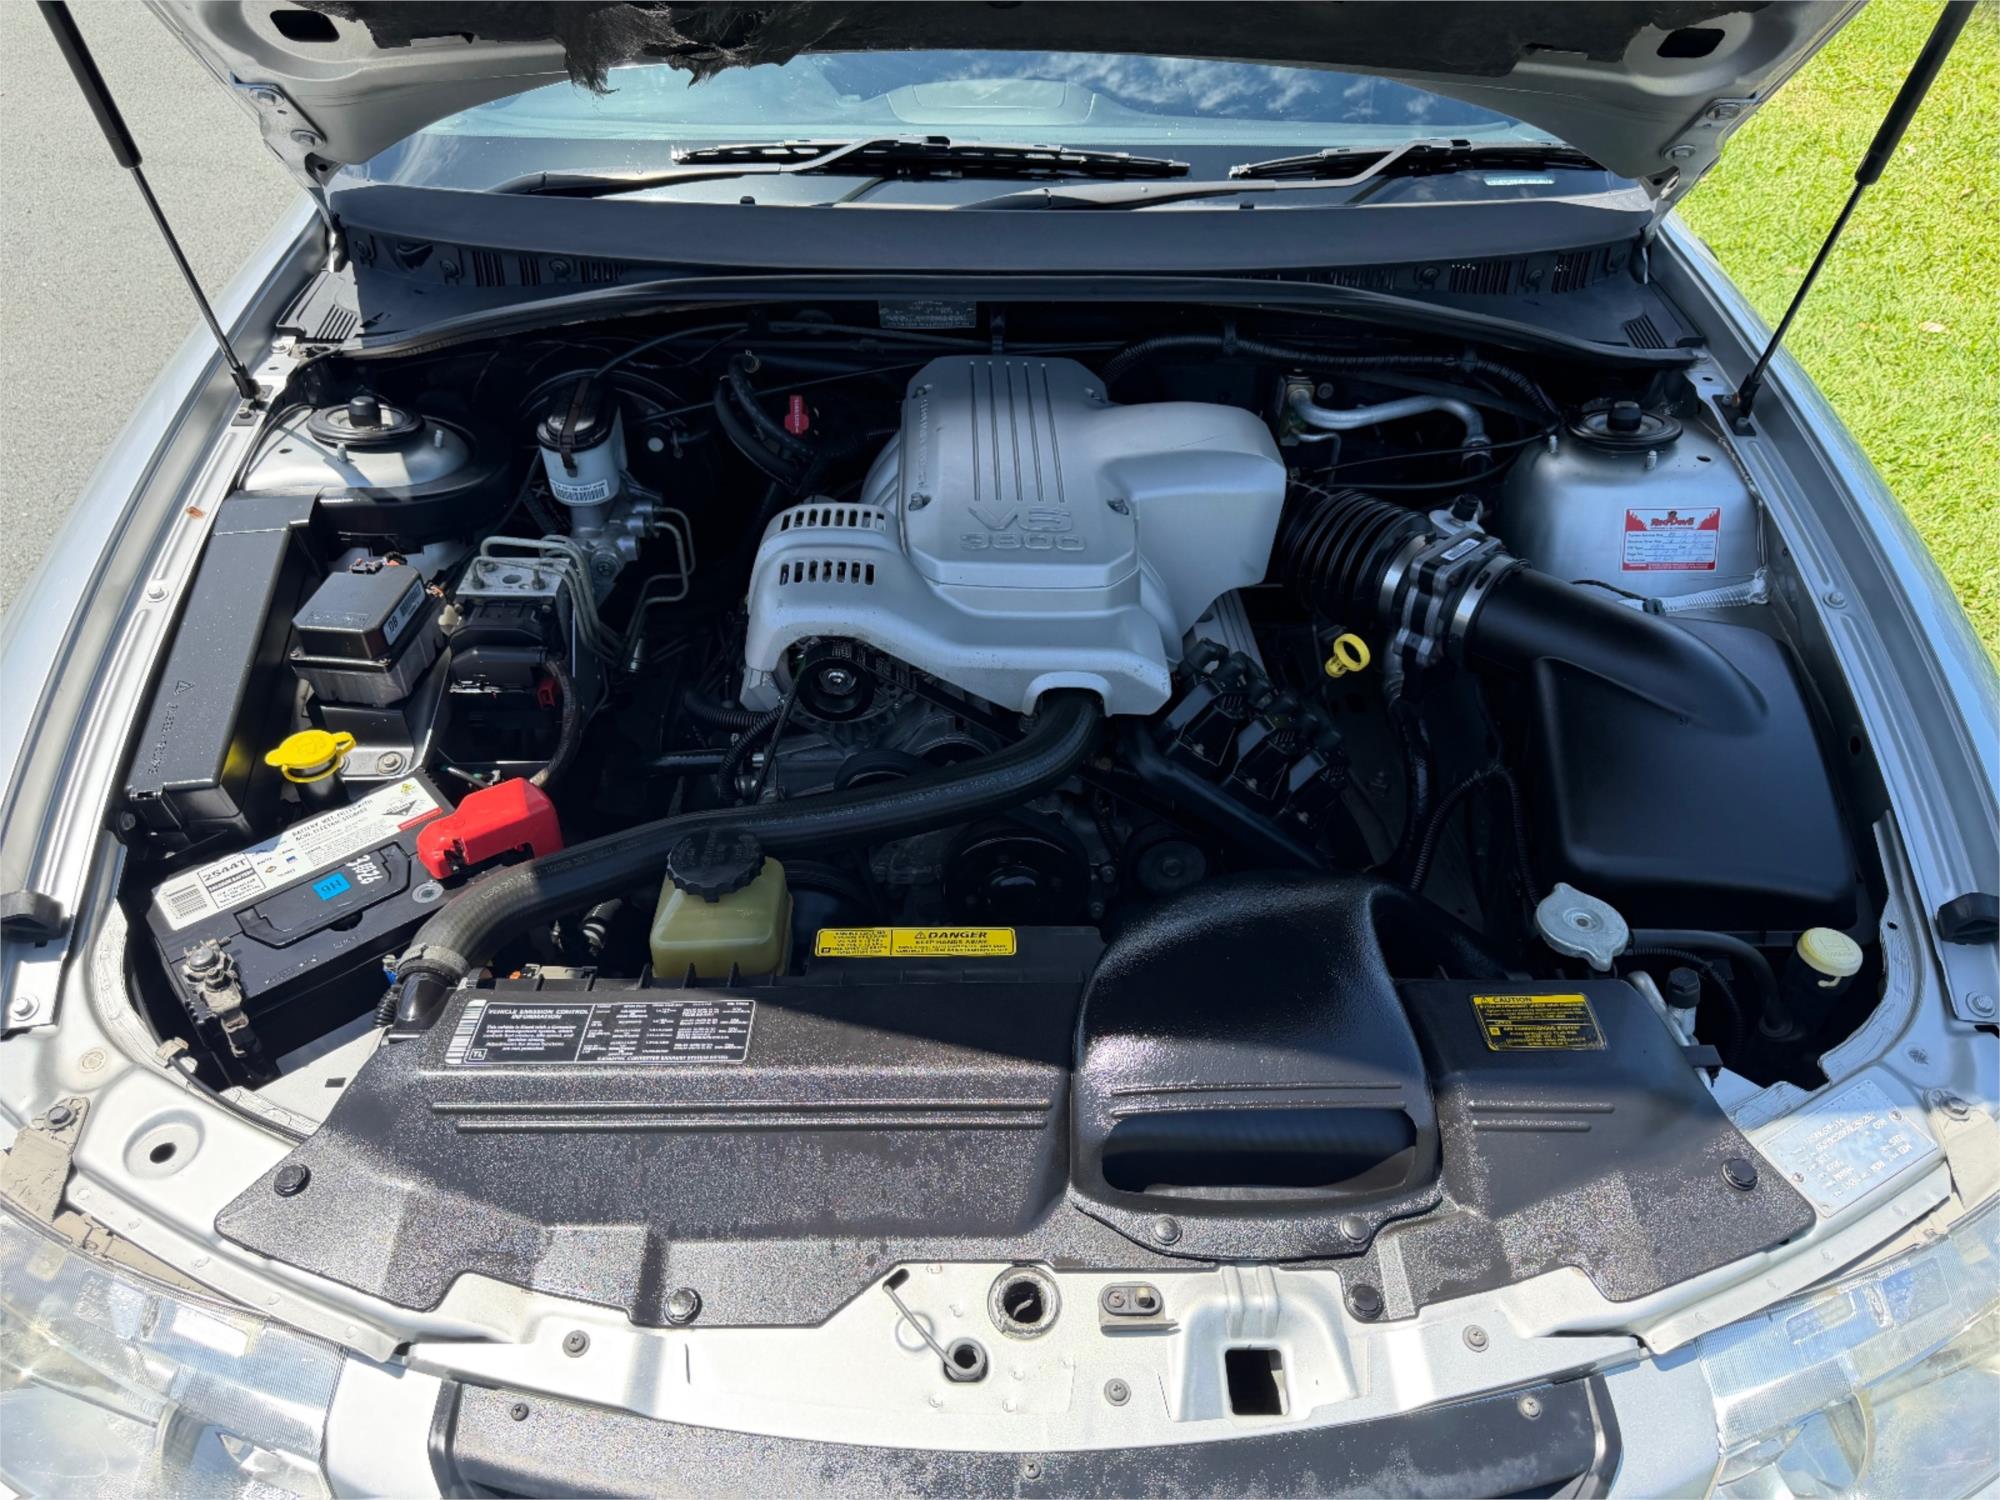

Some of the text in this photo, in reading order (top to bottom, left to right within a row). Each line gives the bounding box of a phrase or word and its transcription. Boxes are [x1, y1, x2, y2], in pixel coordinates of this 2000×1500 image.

[966, 505, 1074, 532] V6
[958, 531, 1087, 551] 3800
[928, 931, 988, 939] DANGER
[1494, 996, 1533, 1004] CAUTION
